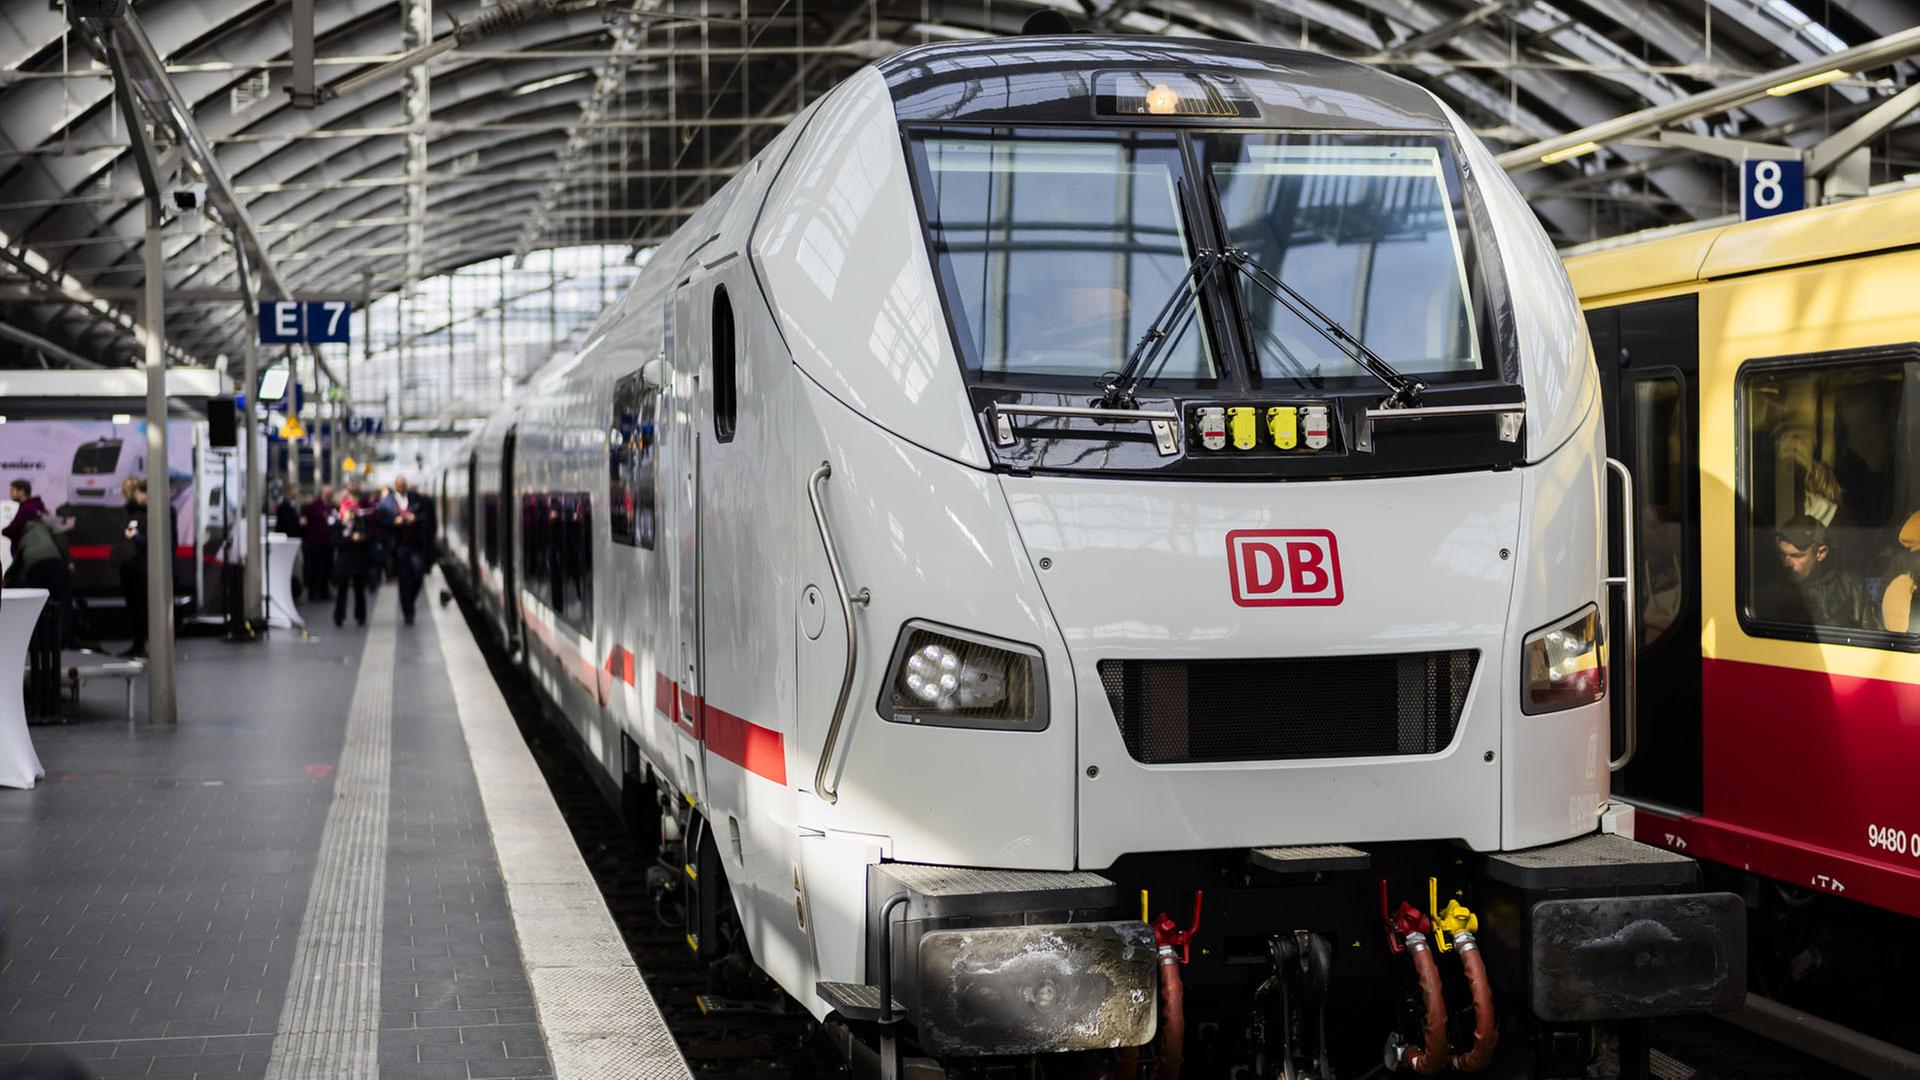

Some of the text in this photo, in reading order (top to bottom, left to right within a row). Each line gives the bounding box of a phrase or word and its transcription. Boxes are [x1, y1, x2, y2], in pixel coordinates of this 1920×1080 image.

[1753, 160, 1783, 210] 8
[275, 301, 346, 337] E 7
[1240, 541, 1331, 595] DB
[1868, 823, 1907, 854] 9480
